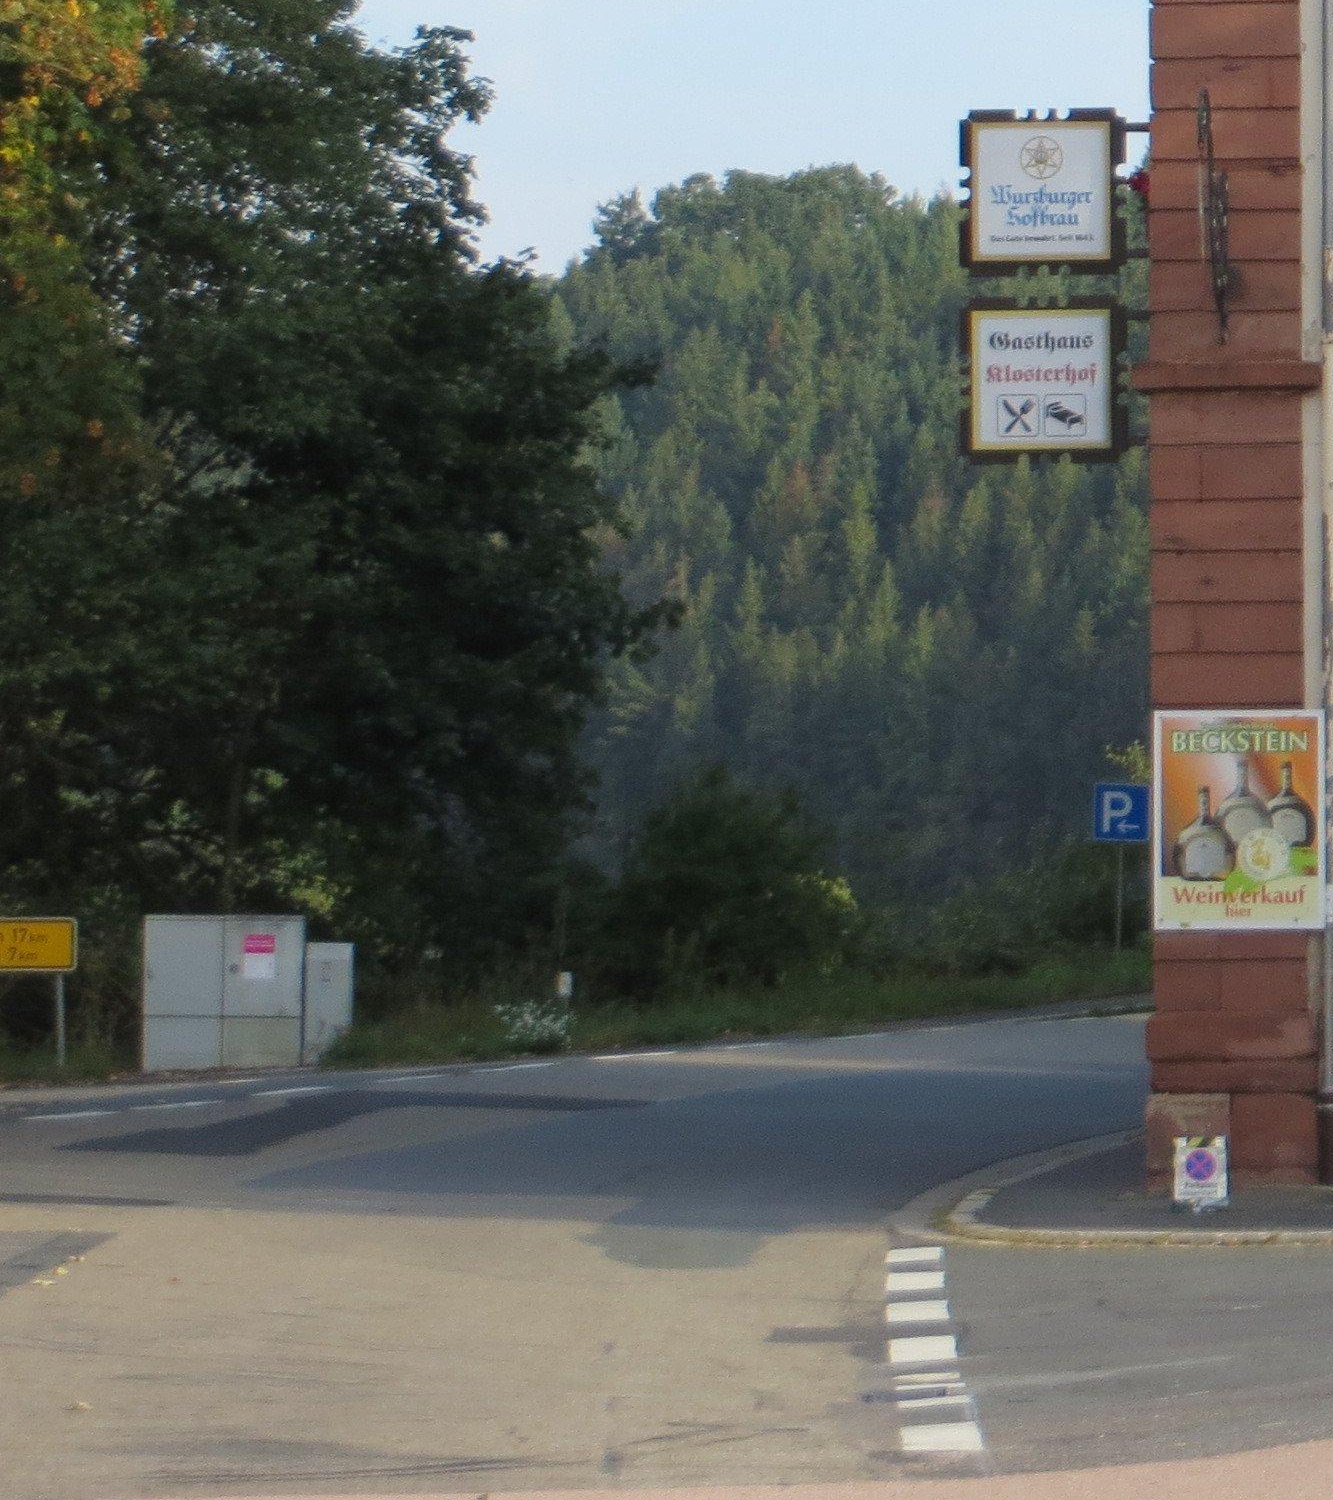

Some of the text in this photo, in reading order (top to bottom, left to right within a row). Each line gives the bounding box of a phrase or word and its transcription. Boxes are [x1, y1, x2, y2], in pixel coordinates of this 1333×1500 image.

[989, 330, 1094, 353] Gasthaus
[986, 362, 1098, 386] Klosterhof
[1171, 729, 1309, 753] BECKSTEIN
[1103, 790, 1133, 833] P
[1172, 884, 1307, 905] Weinverkauf
[1225, 905, 1253, 918] hier
